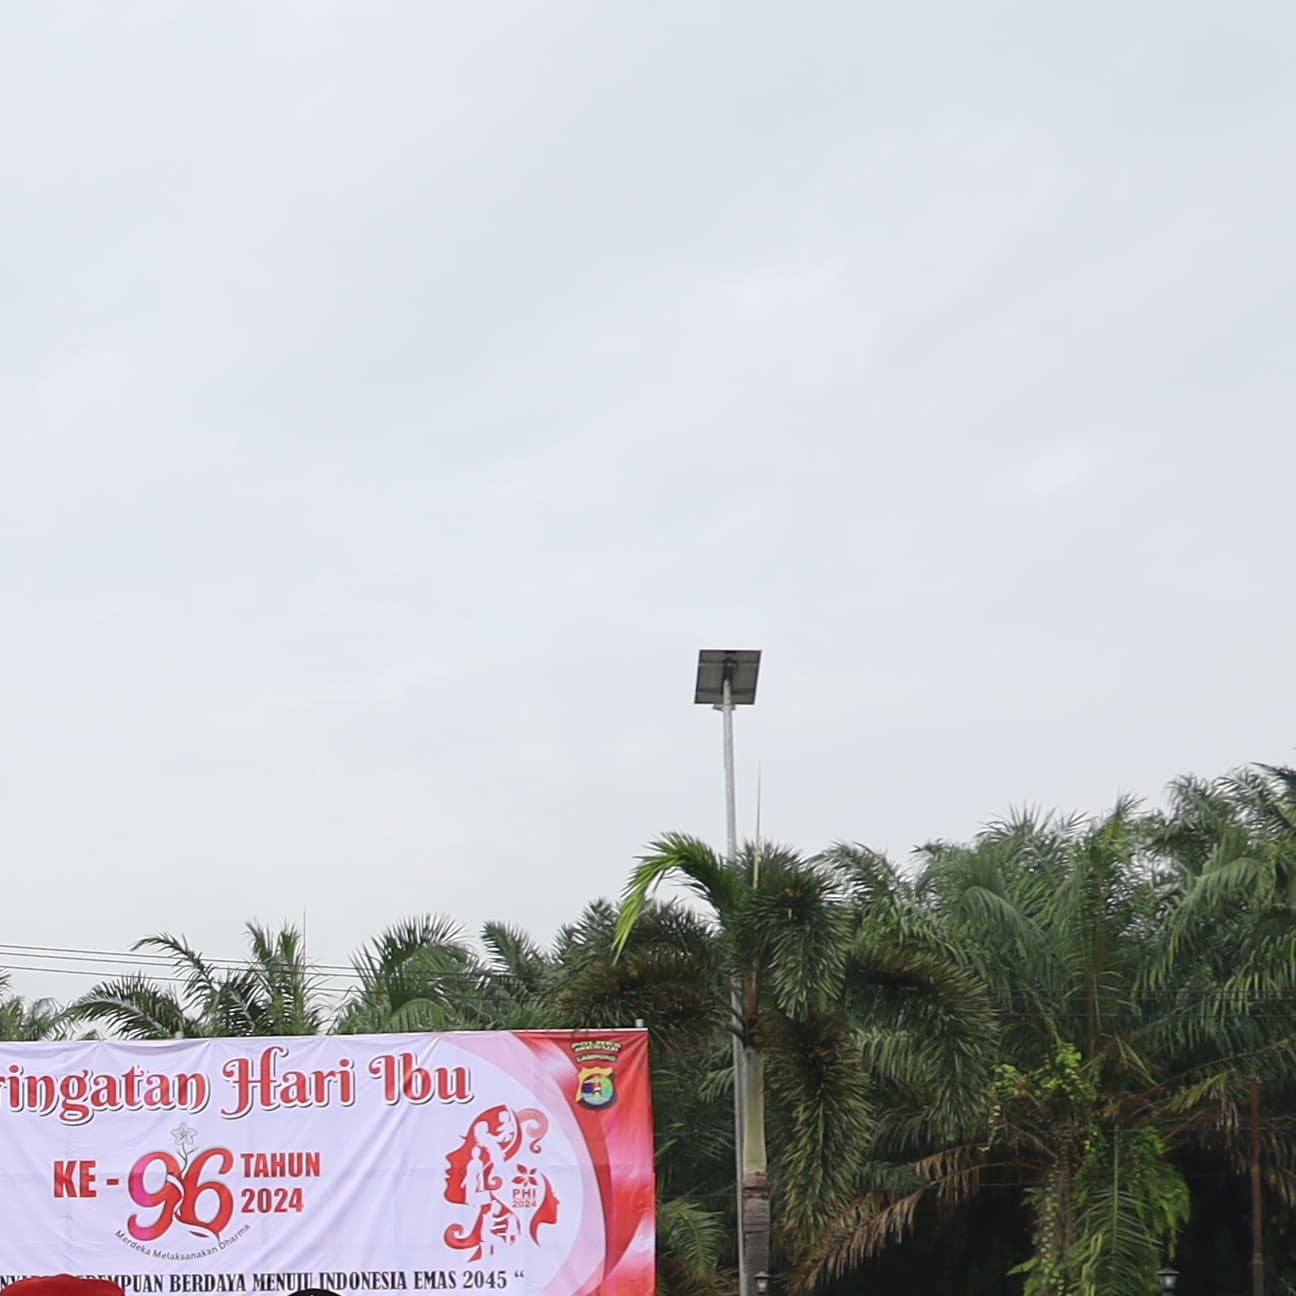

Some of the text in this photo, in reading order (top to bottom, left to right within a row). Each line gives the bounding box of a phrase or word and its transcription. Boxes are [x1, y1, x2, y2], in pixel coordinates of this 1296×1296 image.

[220, 1046, 356, 1119] Hari
[368, 1052, 474, 1105] Ibu
[240, 1152, 321, 1178] TAHUN
[127, 1147, 235, 1242] 96
[240, 1188, 305, 1213] 2024
[512, 1188, 536, 1199] PHI
[114, 1223, 251, 1261] Merdeka Melaksanakan Dharma
[169, 1273, 247, 1293] BERDAYA
[252, 1272, 313, 1292] MENUJU
[319, 1271, 408, 1291] INDONESIA
[413, 1270, 458, 1291] EMAS
[462, 1270, 508, 1290] 2045
